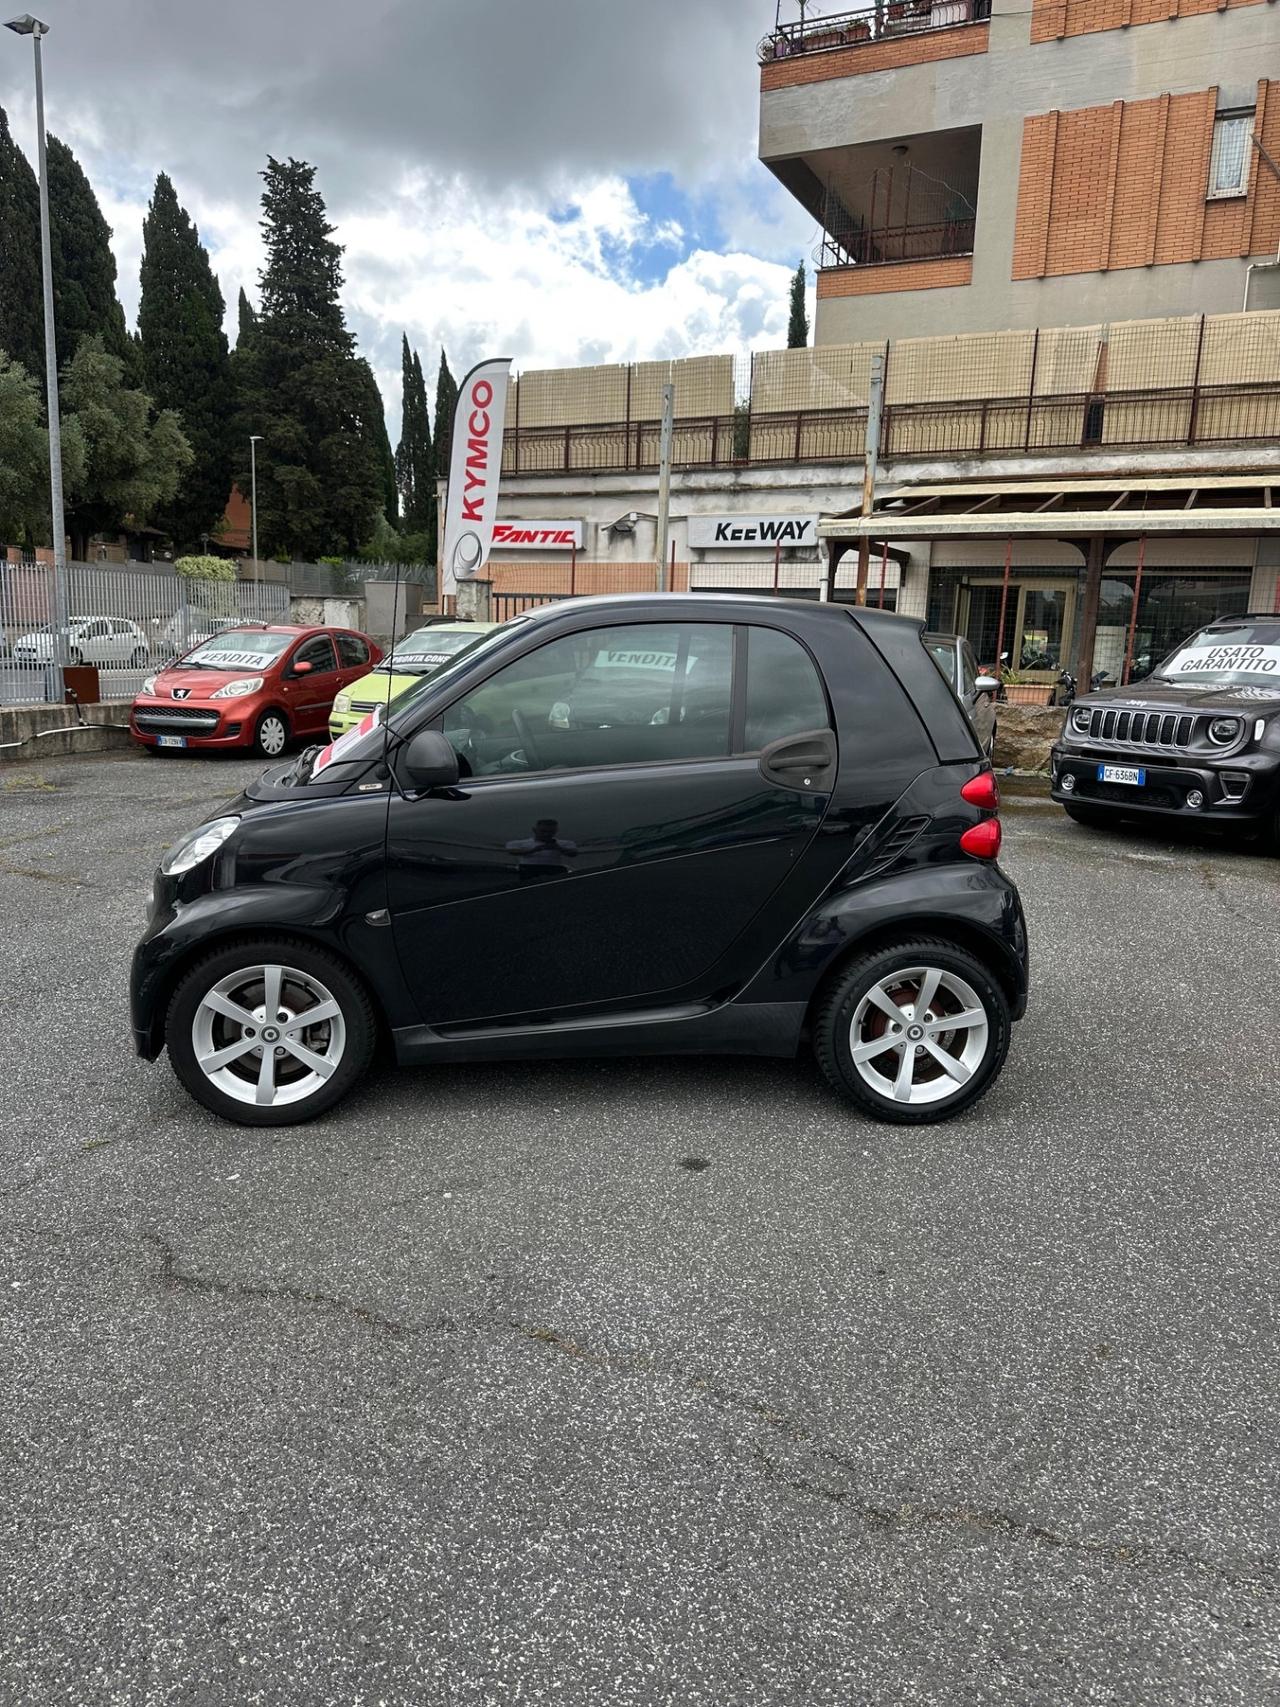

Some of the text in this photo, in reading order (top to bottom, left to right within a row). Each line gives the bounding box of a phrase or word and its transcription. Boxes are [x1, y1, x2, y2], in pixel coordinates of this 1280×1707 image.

[461, 380, 494, 522] KYMCO
[491, 525, 575, 543] FANTIC
[201, 652, 264, 666] VENDITA
[392, 654, 425, 664] PRONTA
[1207, 647, 1264, 659] USATO
[1180, 658, 1277, 672] GARANTITO
[1126, 698, 1148, 707] Jeep
